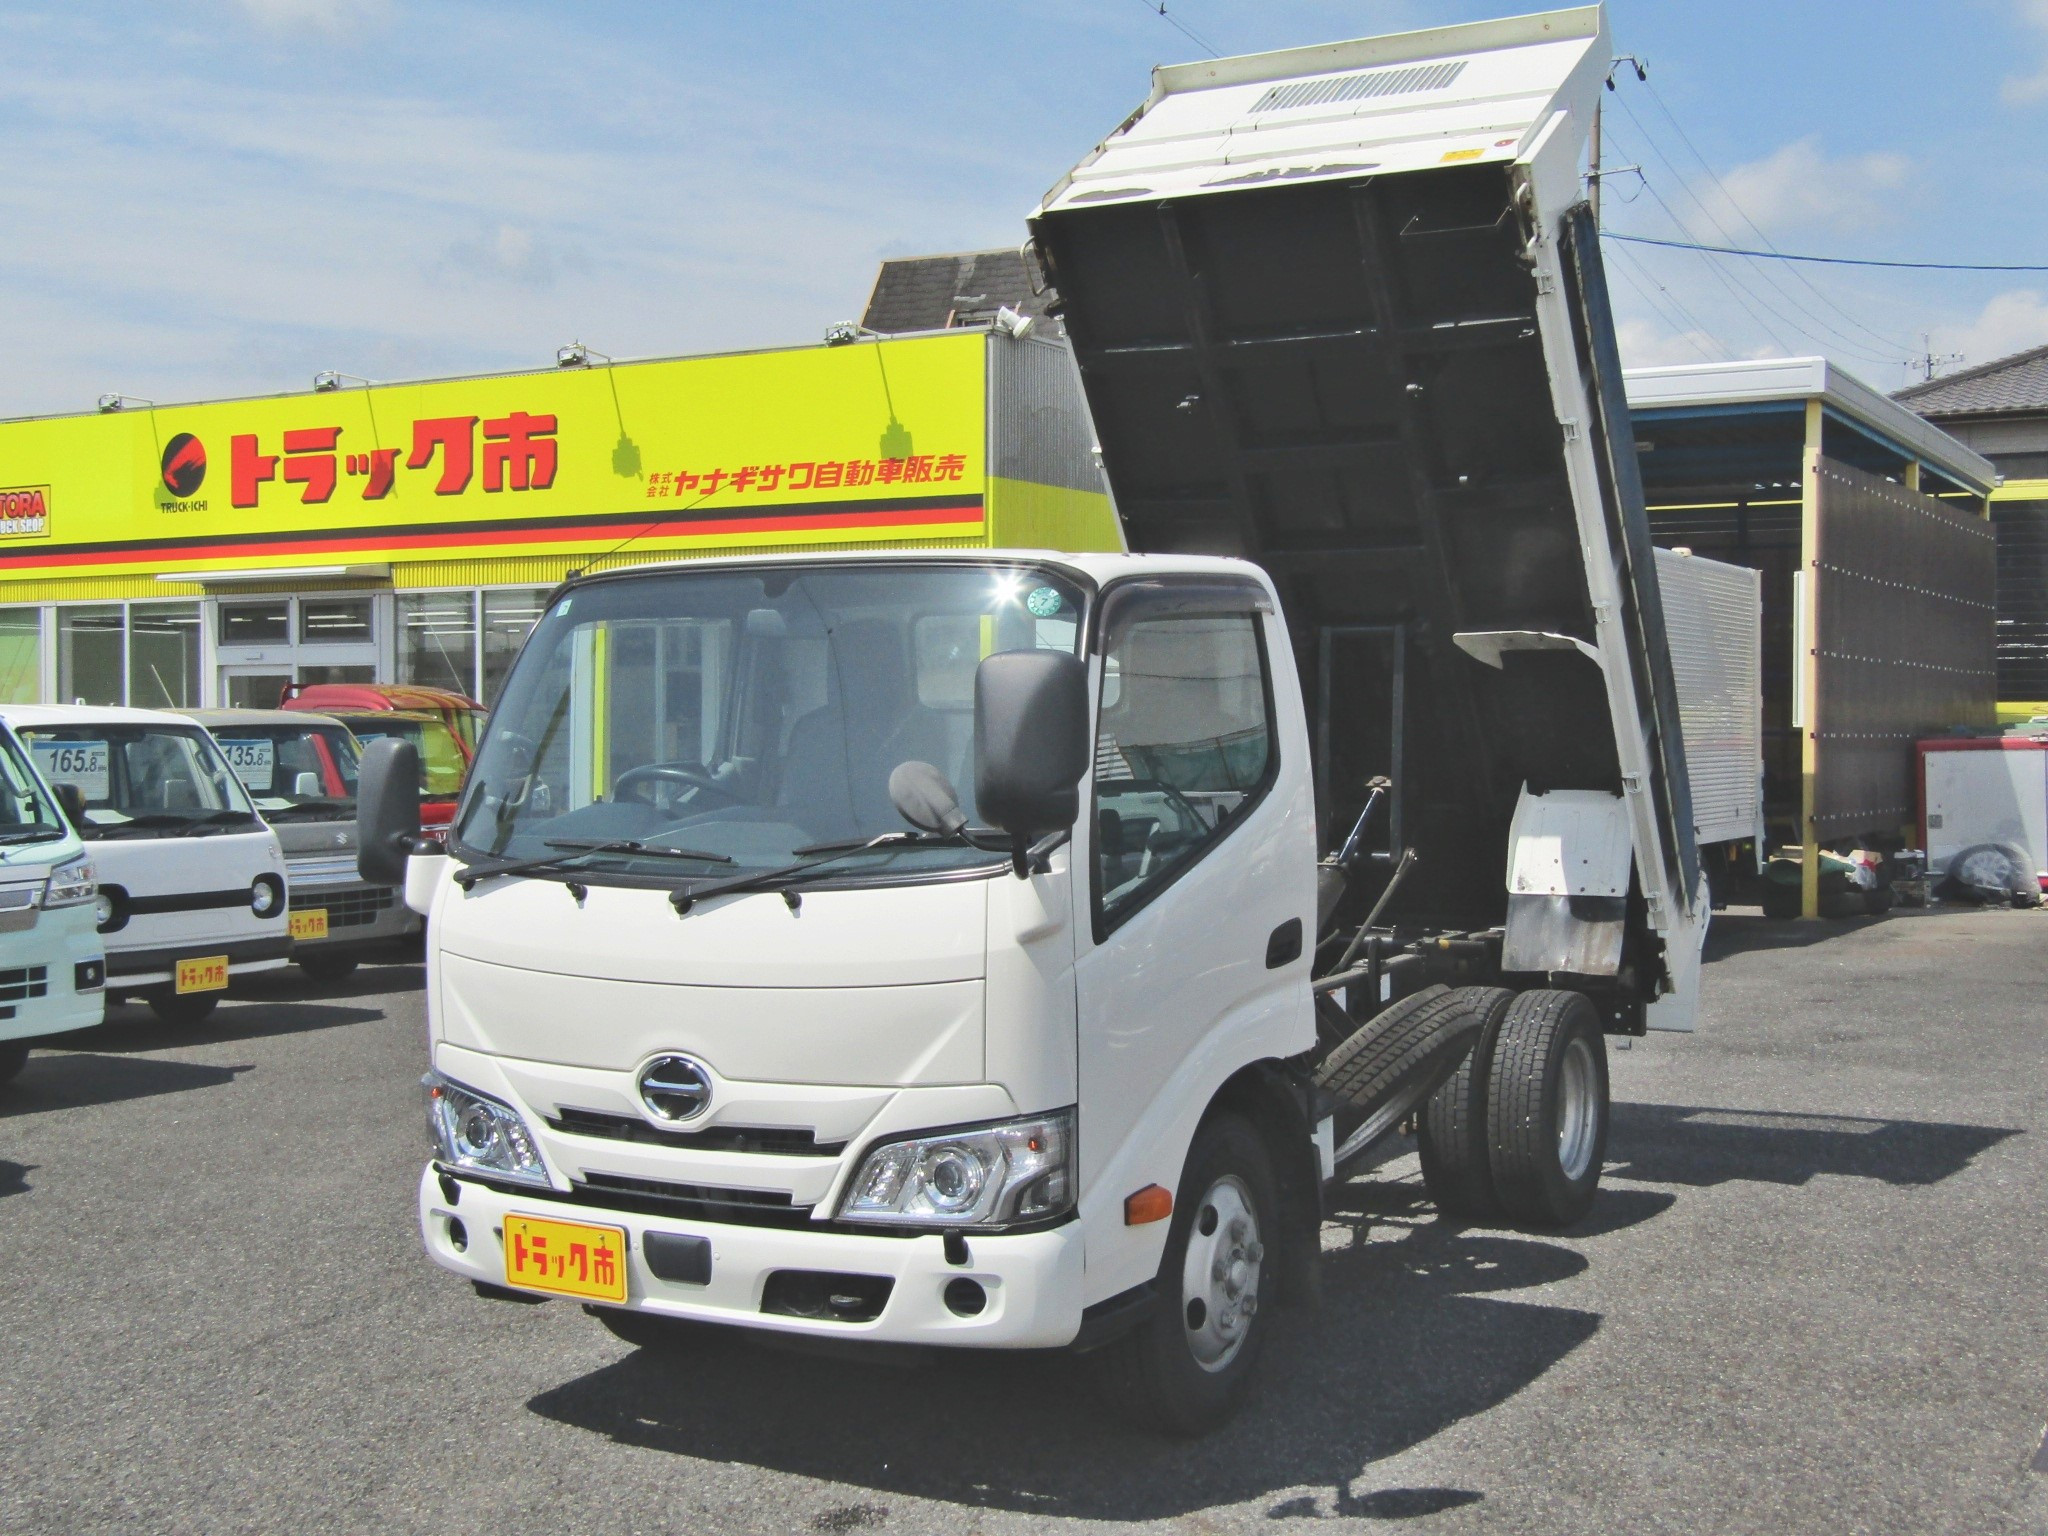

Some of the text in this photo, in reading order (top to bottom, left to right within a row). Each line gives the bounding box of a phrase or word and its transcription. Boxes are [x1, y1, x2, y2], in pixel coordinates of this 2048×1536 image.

[231, 411, 558, 509] トラック市
[674, 454, 967, 496] ヤナギサワ自動車販売
[646, 485, 670, 497] 会社
[649, 471, 673, 485] 株式
[181, 965, 224, 987] トラック市
[514, 1233, 615, 1286] トラック市
